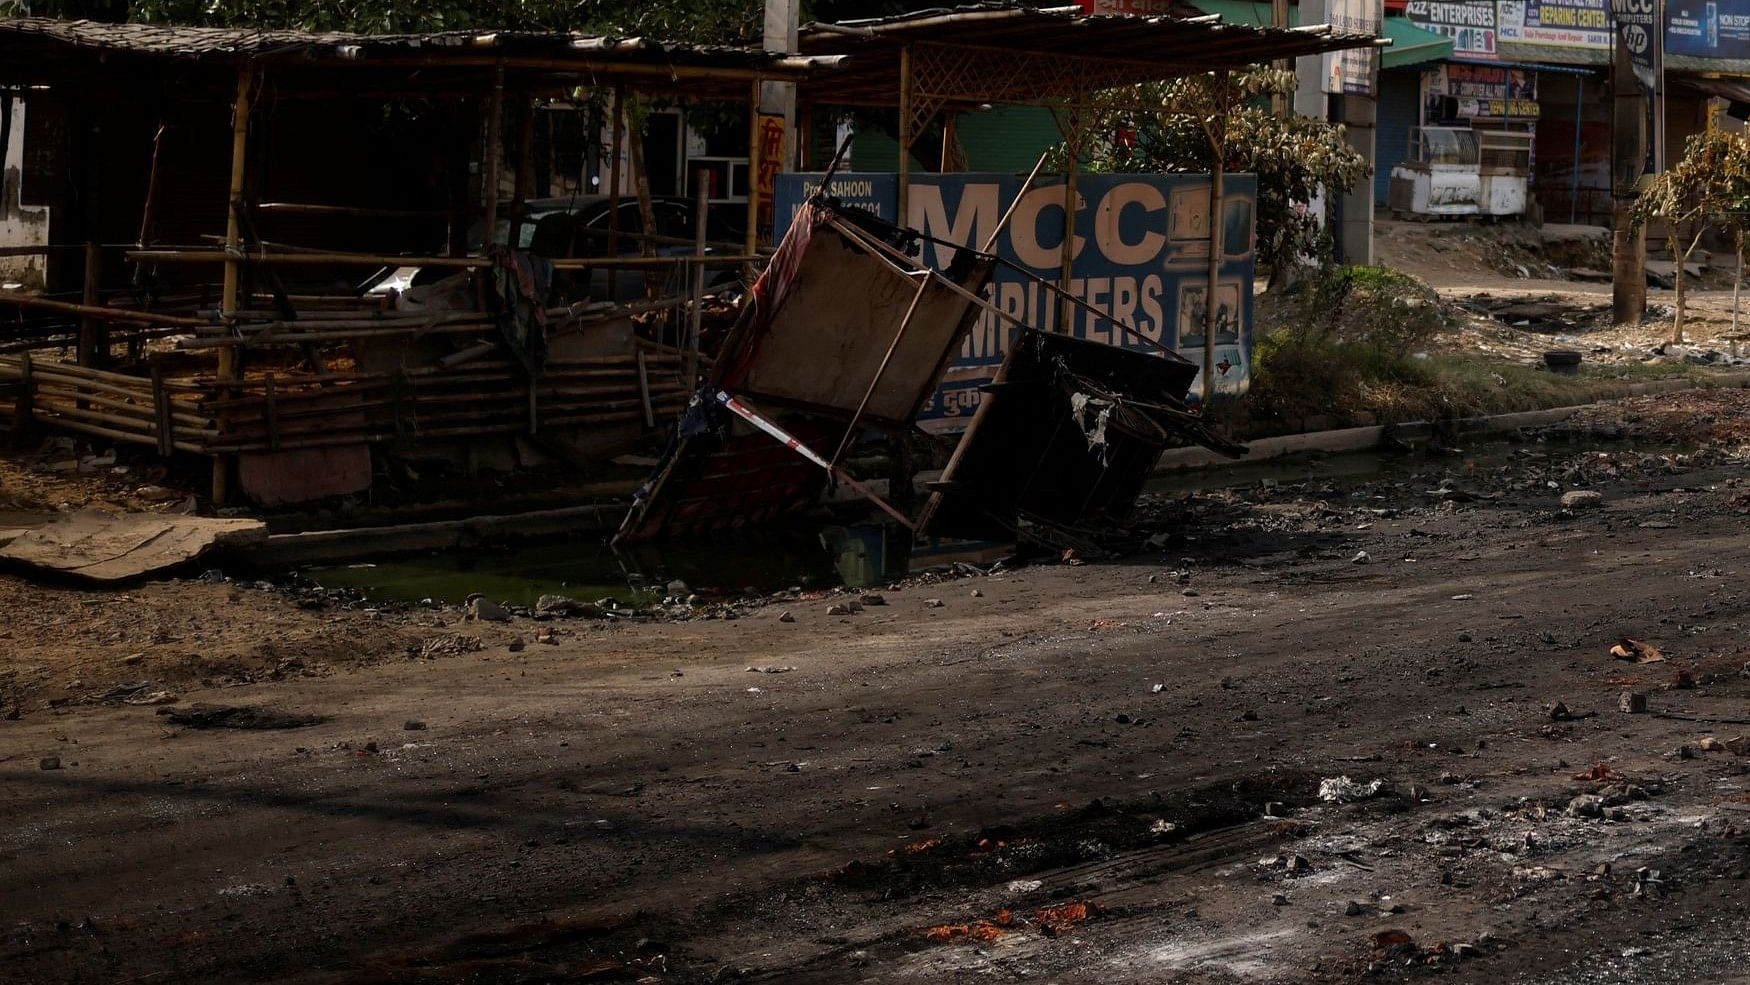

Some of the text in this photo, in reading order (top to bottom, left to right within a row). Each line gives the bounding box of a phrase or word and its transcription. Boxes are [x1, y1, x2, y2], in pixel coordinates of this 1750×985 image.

[1407, 0, 1495, 27] A2Z ENTERPRISES
[1734, 16, 1750, 27] STOP
[1500, 26, 1519, 37] HCL
[831, 181, 872, 197] SAHOON
[907, 183, 1166, 272] MCC
